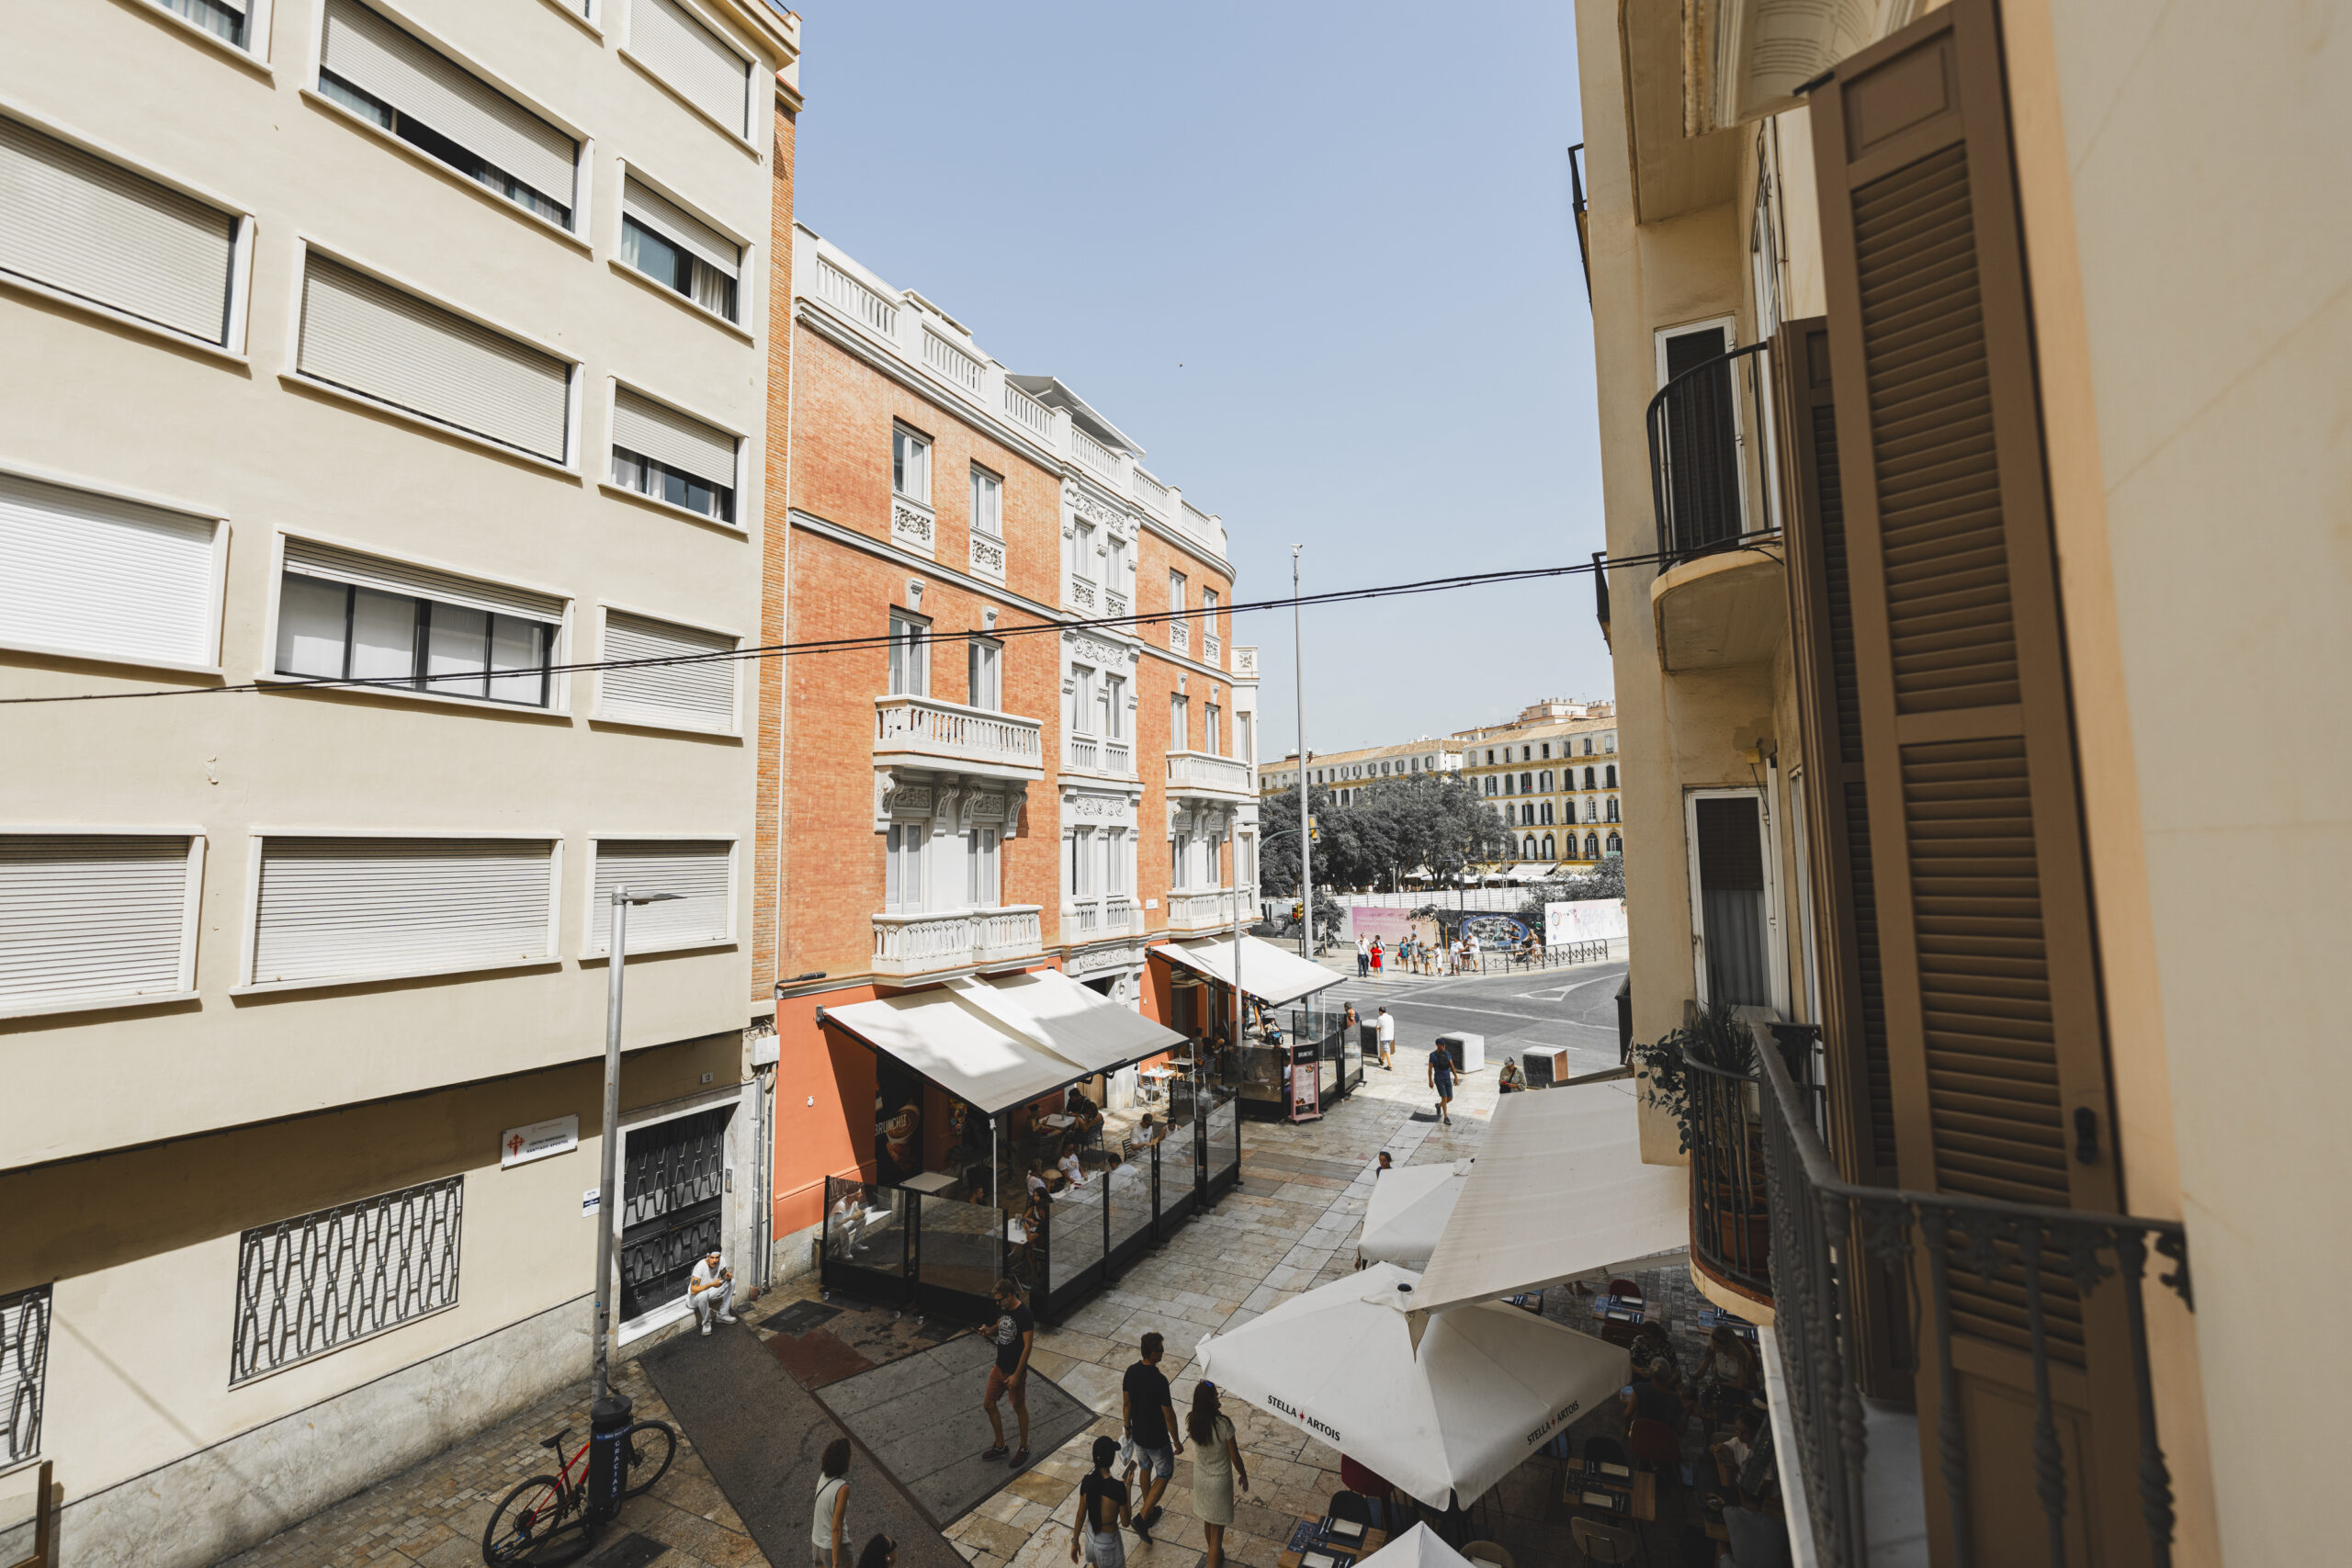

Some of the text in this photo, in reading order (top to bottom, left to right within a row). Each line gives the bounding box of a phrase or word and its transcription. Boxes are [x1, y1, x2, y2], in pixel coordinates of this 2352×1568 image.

[1268, 1394, 1340, 1441] STELLA ARTOIS
[1527, 1400, 1579, 1446] STELLA ARTOIS
[612, 1440, 620, 1493] GRACIAS
